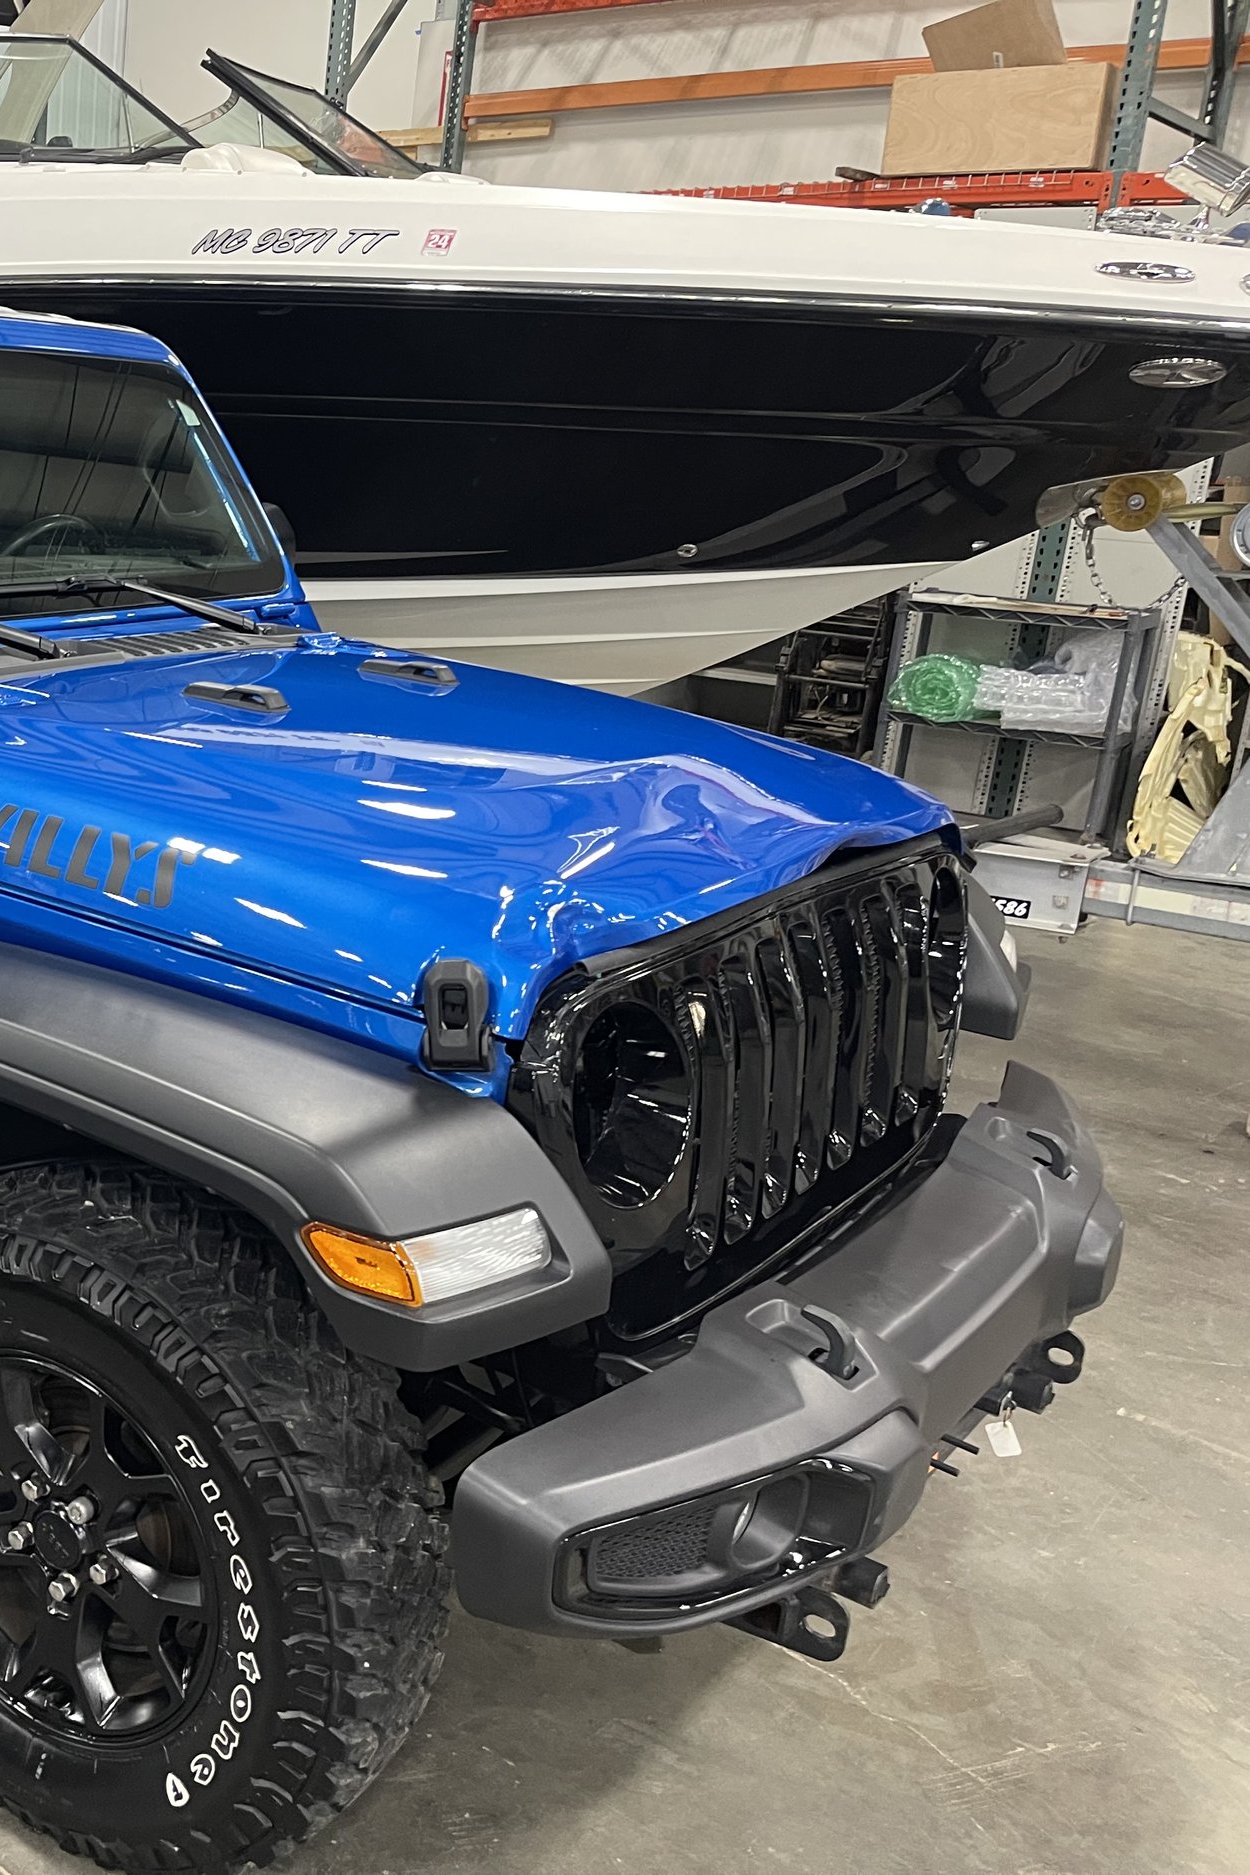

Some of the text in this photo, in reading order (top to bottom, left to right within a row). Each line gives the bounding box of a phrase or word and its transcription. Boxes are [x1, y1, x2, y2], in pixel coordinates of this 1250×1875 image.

[191, 228, 400, 255] MC 9871 TT
[427, 233, 450, 249] 24
[991, 897, 1028, 917] 586
[174, 1434, 261, 1786] Firestone
